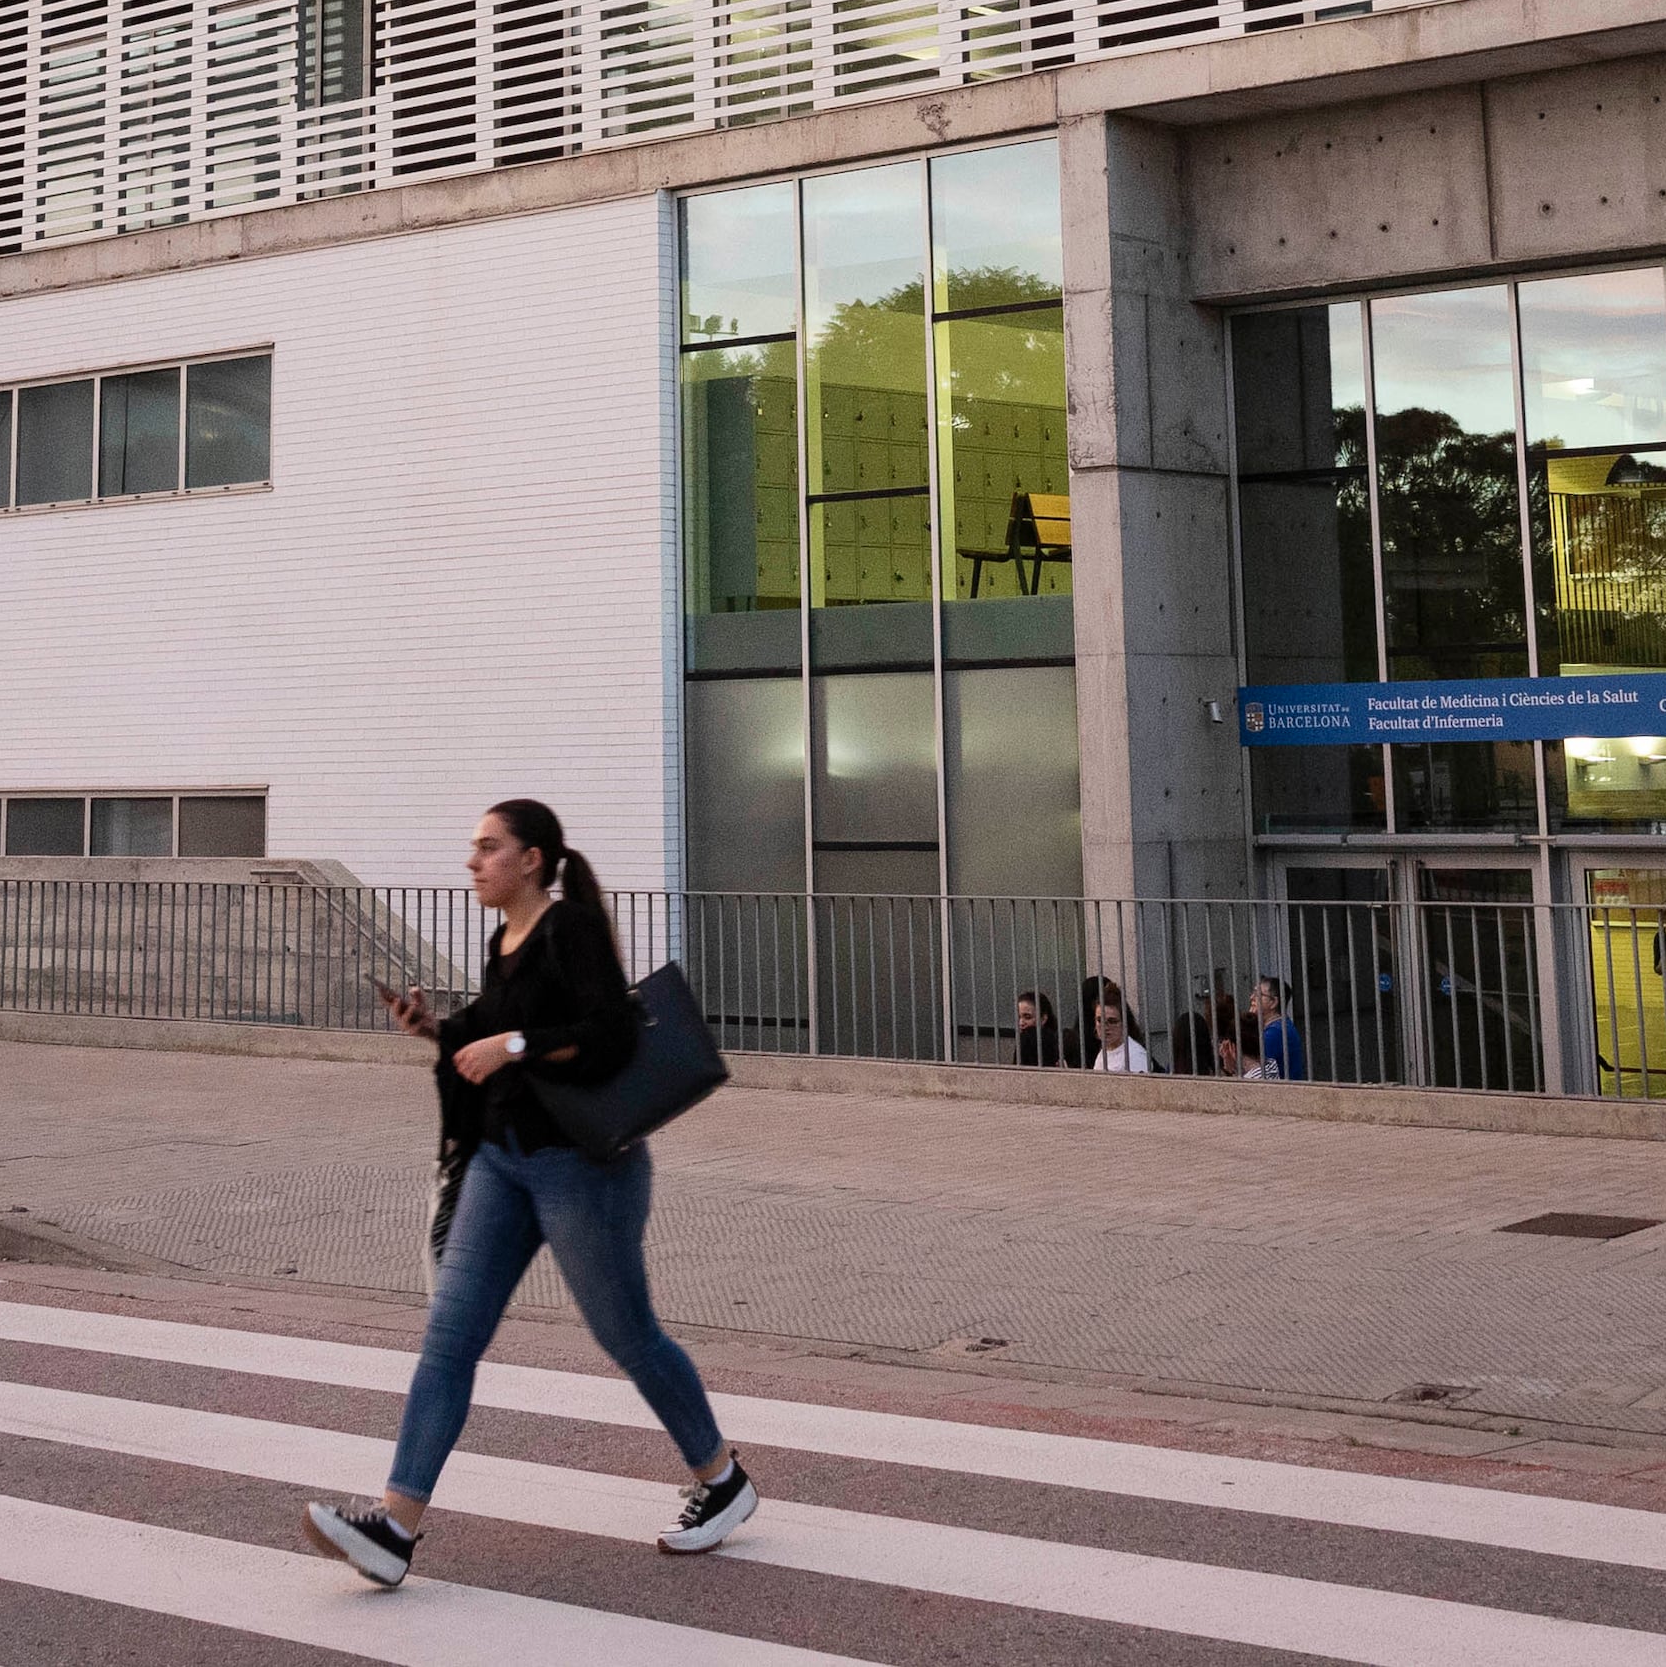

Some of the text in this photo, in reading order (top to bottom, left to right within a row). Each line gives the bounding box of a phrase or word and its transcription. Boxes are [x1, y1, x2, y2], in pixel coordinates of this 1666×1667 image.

[1368, 688, 1639, 711] Facultat de Medicina i Ciències de la Salut
[1269, 715, 1351, 729] BARCELONA
[1369, 715, 1504, 730] Facultat d'Infermeria
